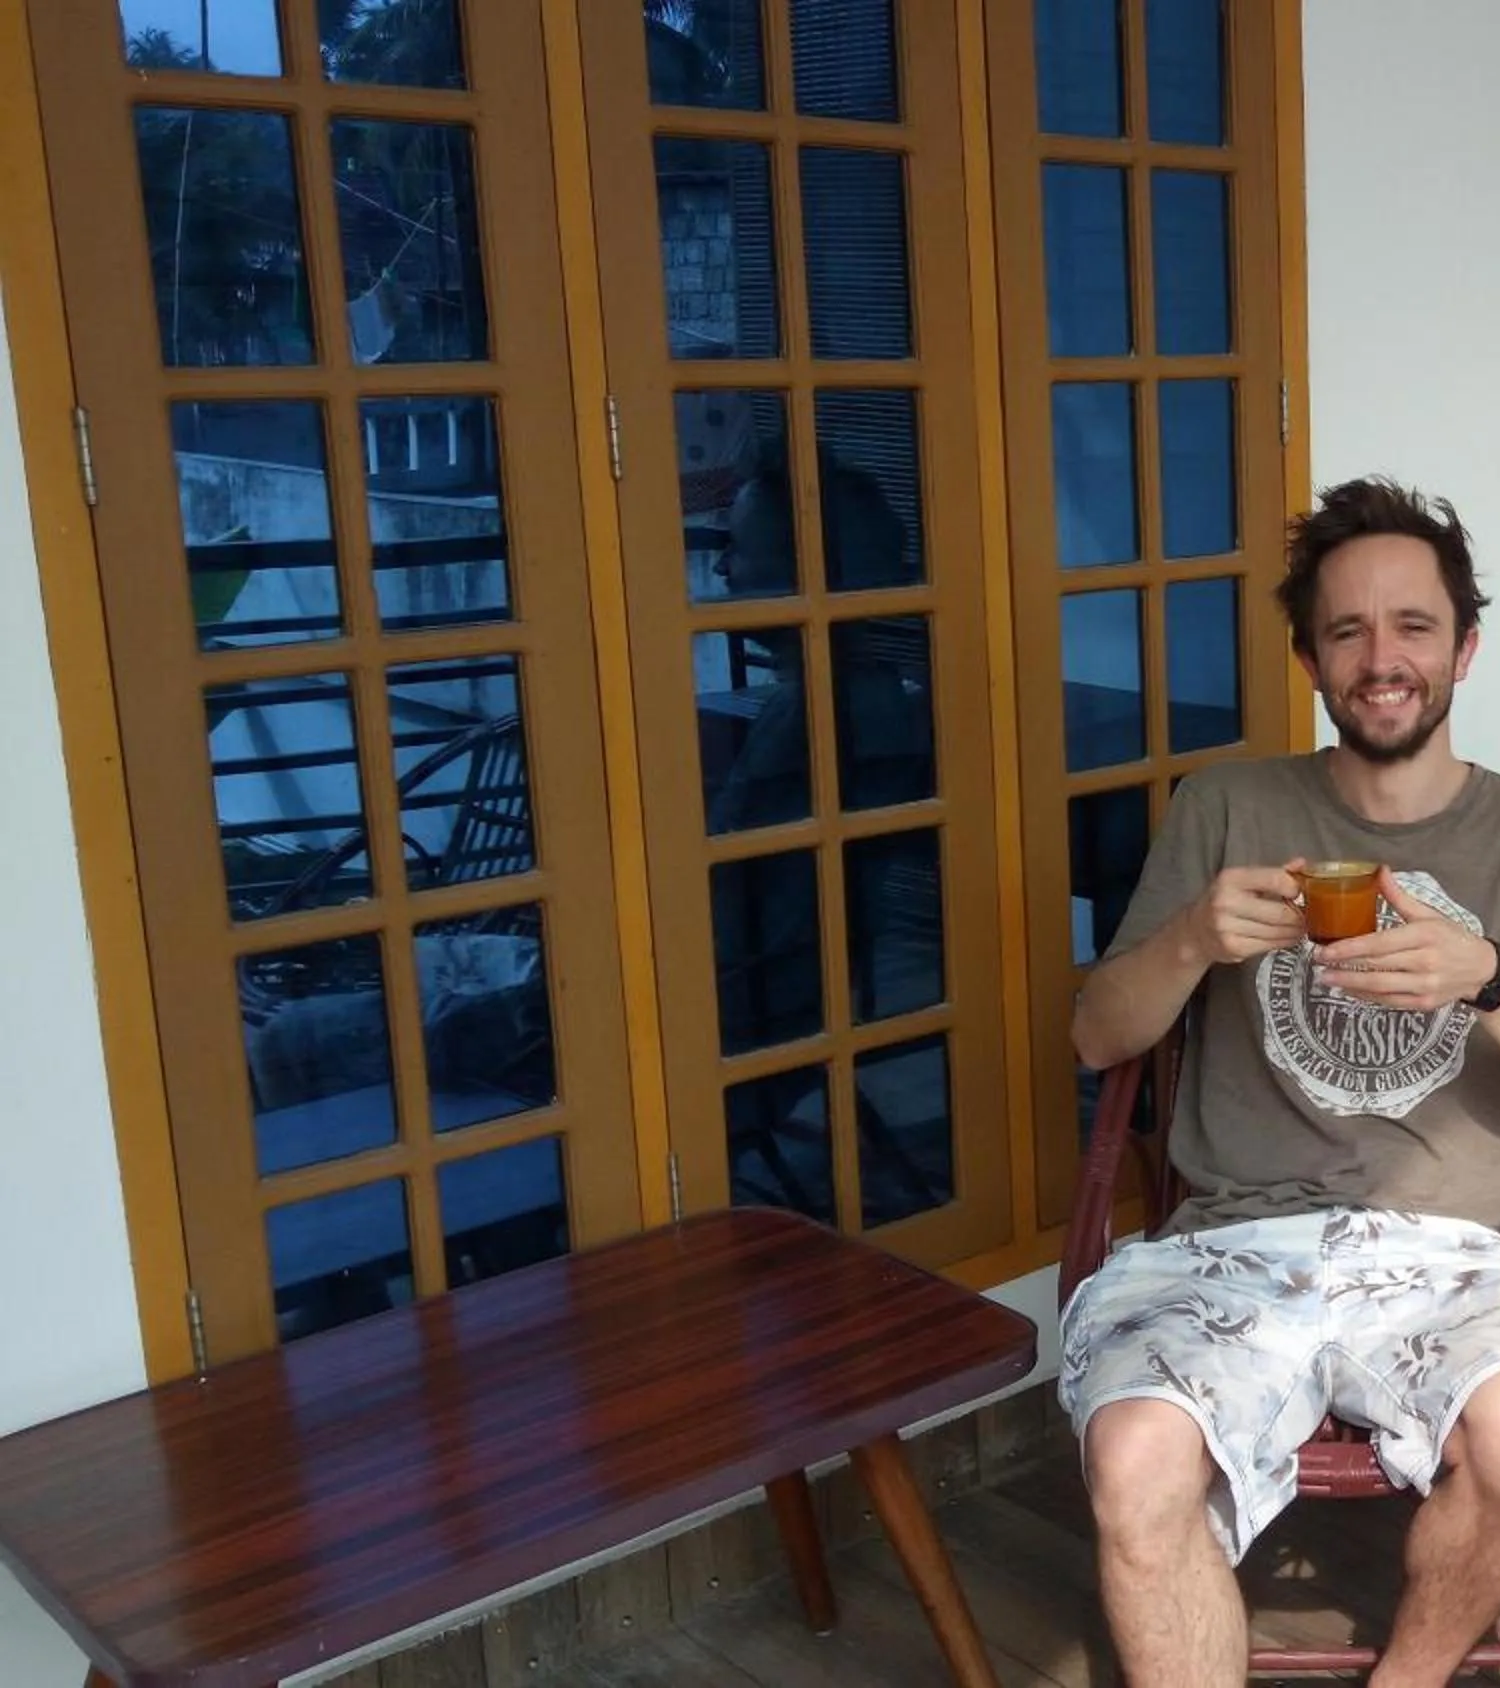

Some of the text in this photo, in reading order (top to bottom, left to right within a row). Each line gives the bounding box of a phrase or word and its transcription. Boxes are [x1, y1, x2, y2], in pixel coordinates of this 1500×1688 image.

[1270, 999, 1467, 1092] SATISFACTION GUARANTEED
[1315, 1004, 1426, 1066] CLASSICS
